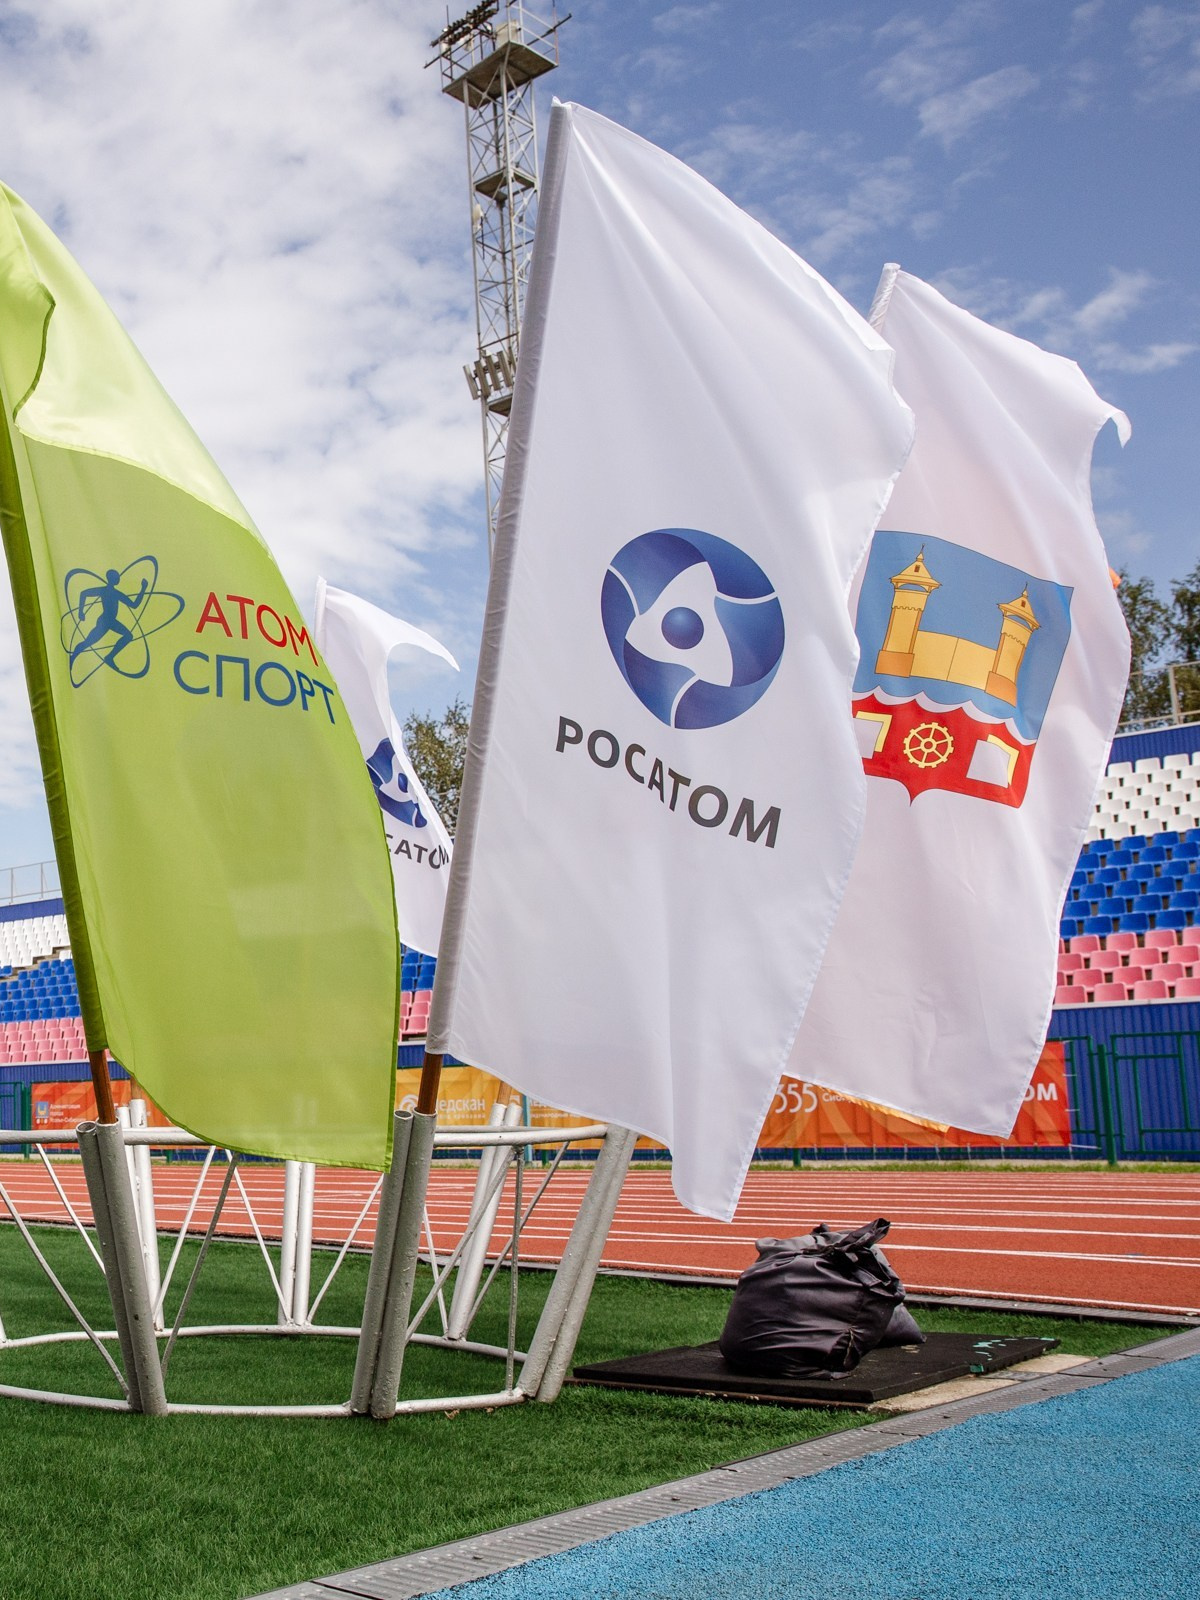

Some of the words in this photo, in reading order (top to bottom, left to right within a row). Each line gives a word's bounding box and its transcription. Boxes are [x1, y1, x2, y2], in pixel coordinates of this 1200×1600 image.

[195, 591, 320, 667] АТОМ
[173, 650, 335, 725] СПОРТ
[555, 715, 781, 849] РОСАТОМ
[386, 833, 450, 870] АТОМ
[436, 1098, 486, 1113] едскан
